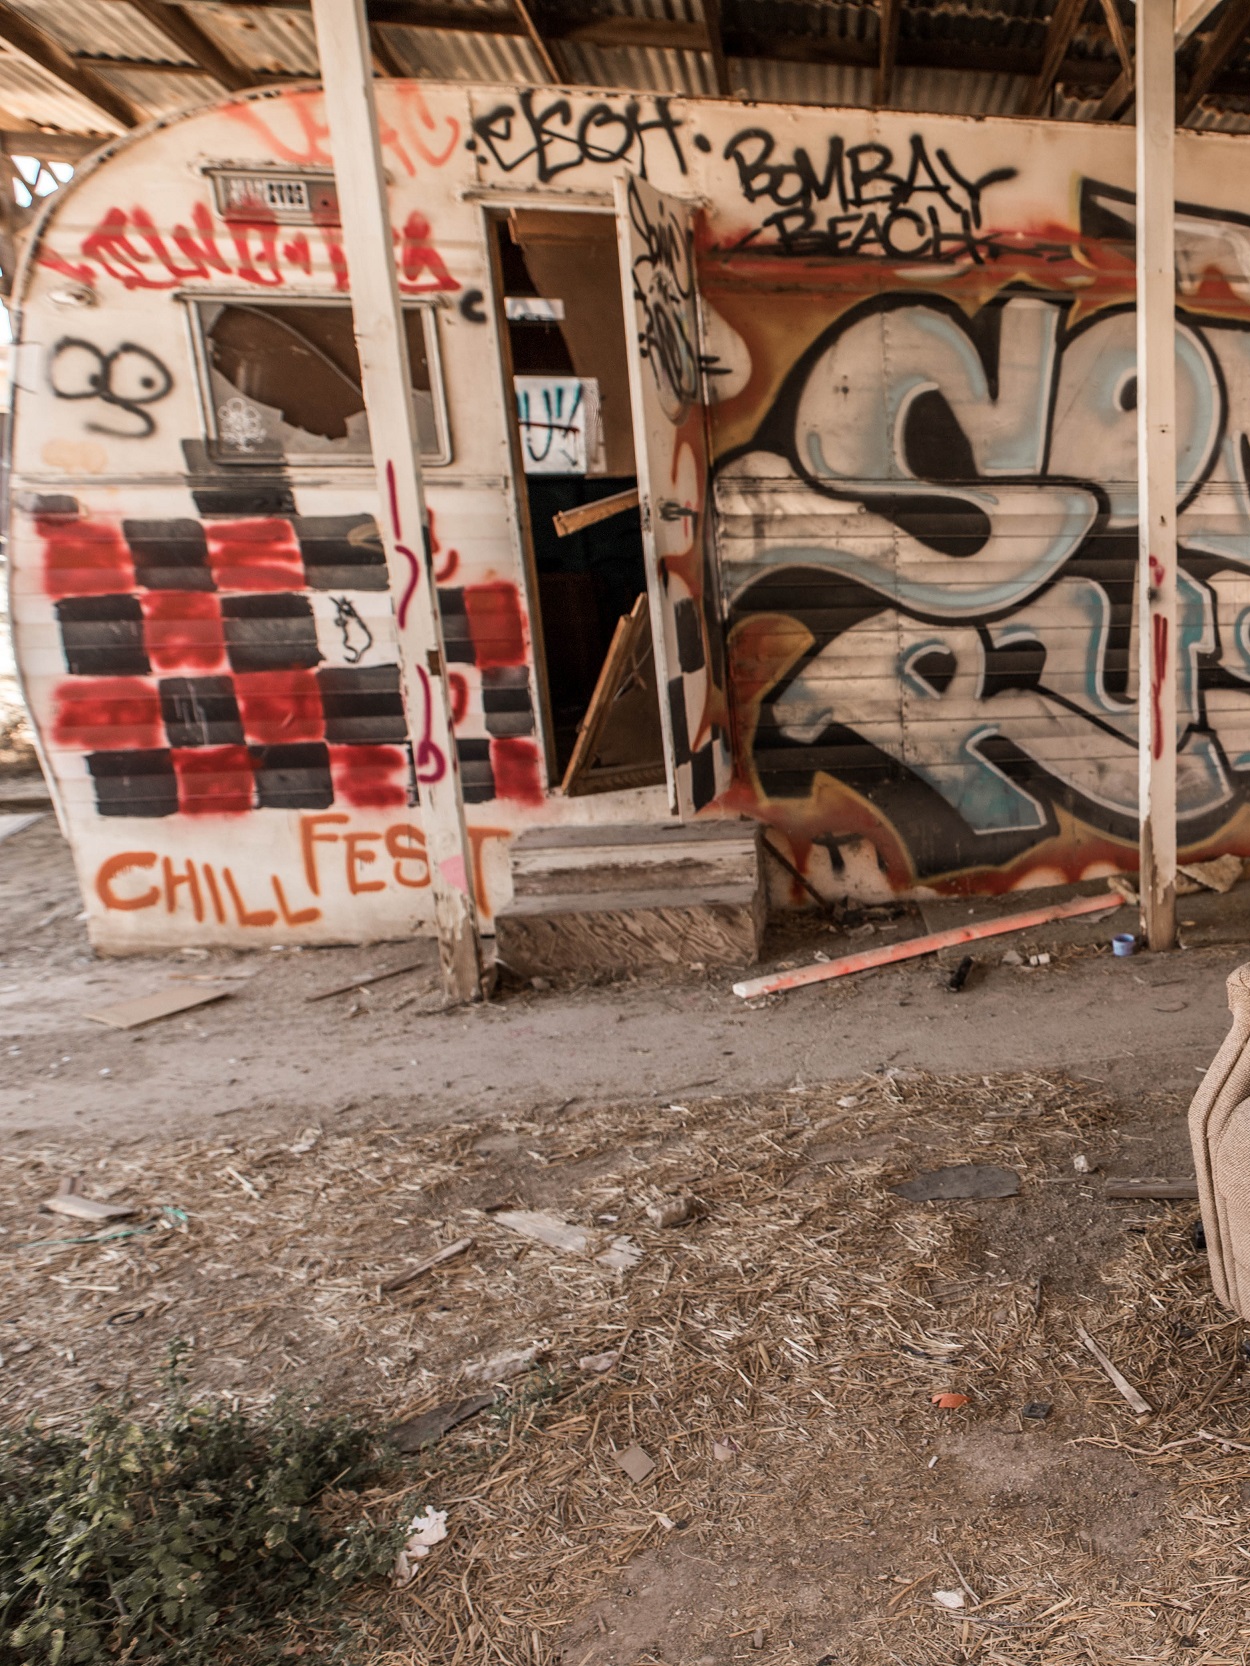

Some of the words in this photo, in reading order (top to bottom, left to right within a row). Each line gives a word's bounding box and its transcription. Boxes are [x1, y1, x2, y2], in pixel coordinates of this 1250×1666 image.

[760, 205, 986, 265] BEACH
[95, 851, 320, 926] CHILL
[301, 813, 513, 919] FEST
